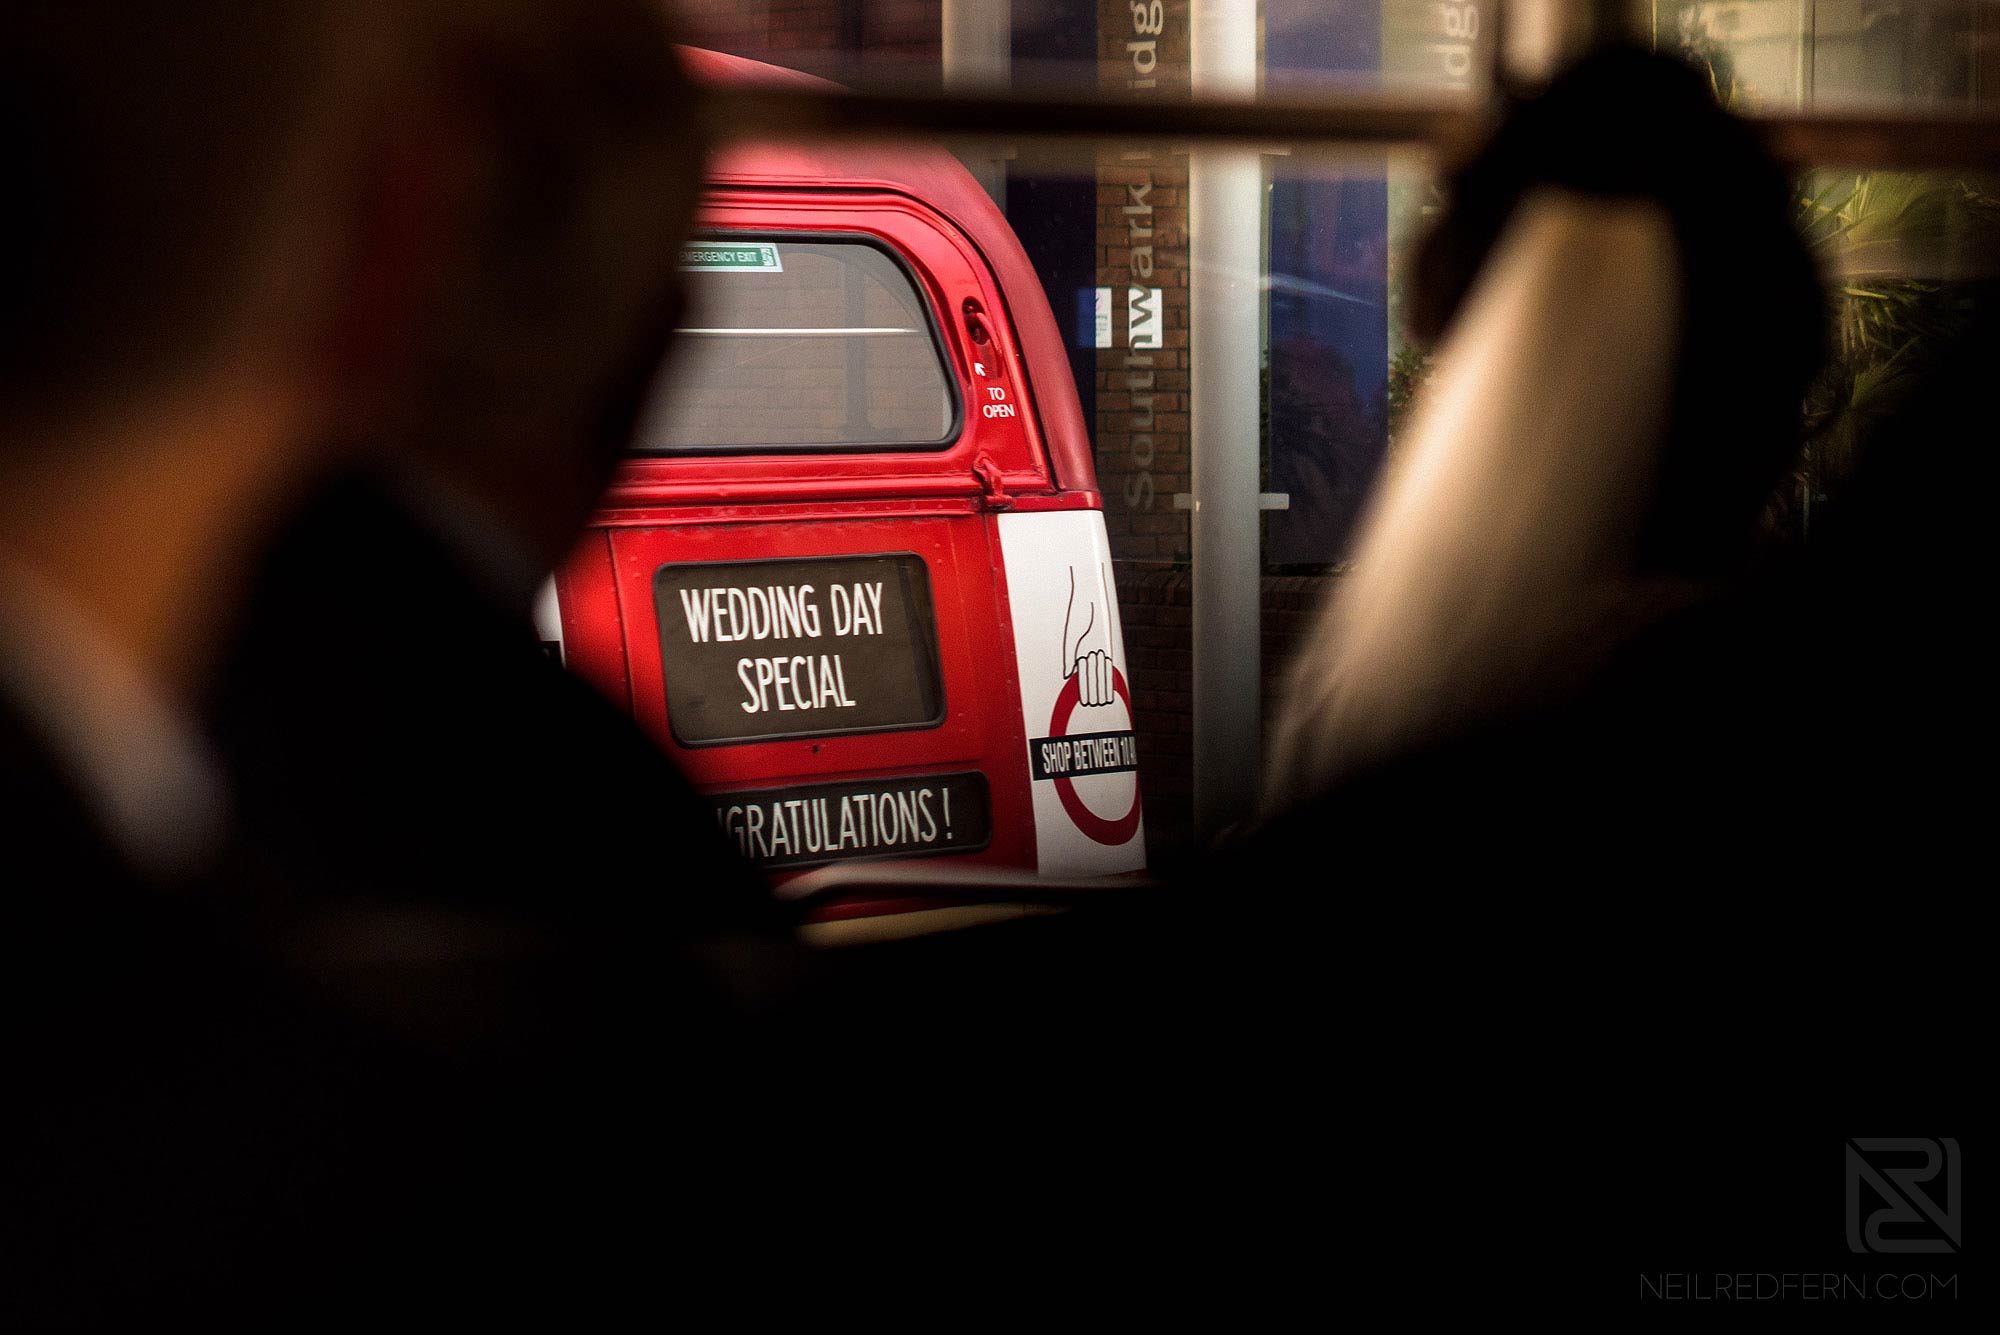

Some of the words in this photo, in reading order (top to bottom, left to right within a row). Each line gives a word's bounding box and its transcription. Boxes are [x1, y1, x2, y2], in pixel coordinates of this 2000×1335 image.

[737, 251, 758, 262] EXIT
[1122, 184, 1155, 509] Southwark
[983, 404, 1015, 418] OPEN
[986, 387, 1005, 400] TO
[680, 584, 821, 642] WEDDING
[830, 582, 883, 636] DAY
[737, 655, 856, 713] SPECIAL
[1041, 742, 1071, 774] SHOP
[1073, 737, 1121, 770] BETWEEN
[717, 787, 952, 859] GRATULATIONS!
